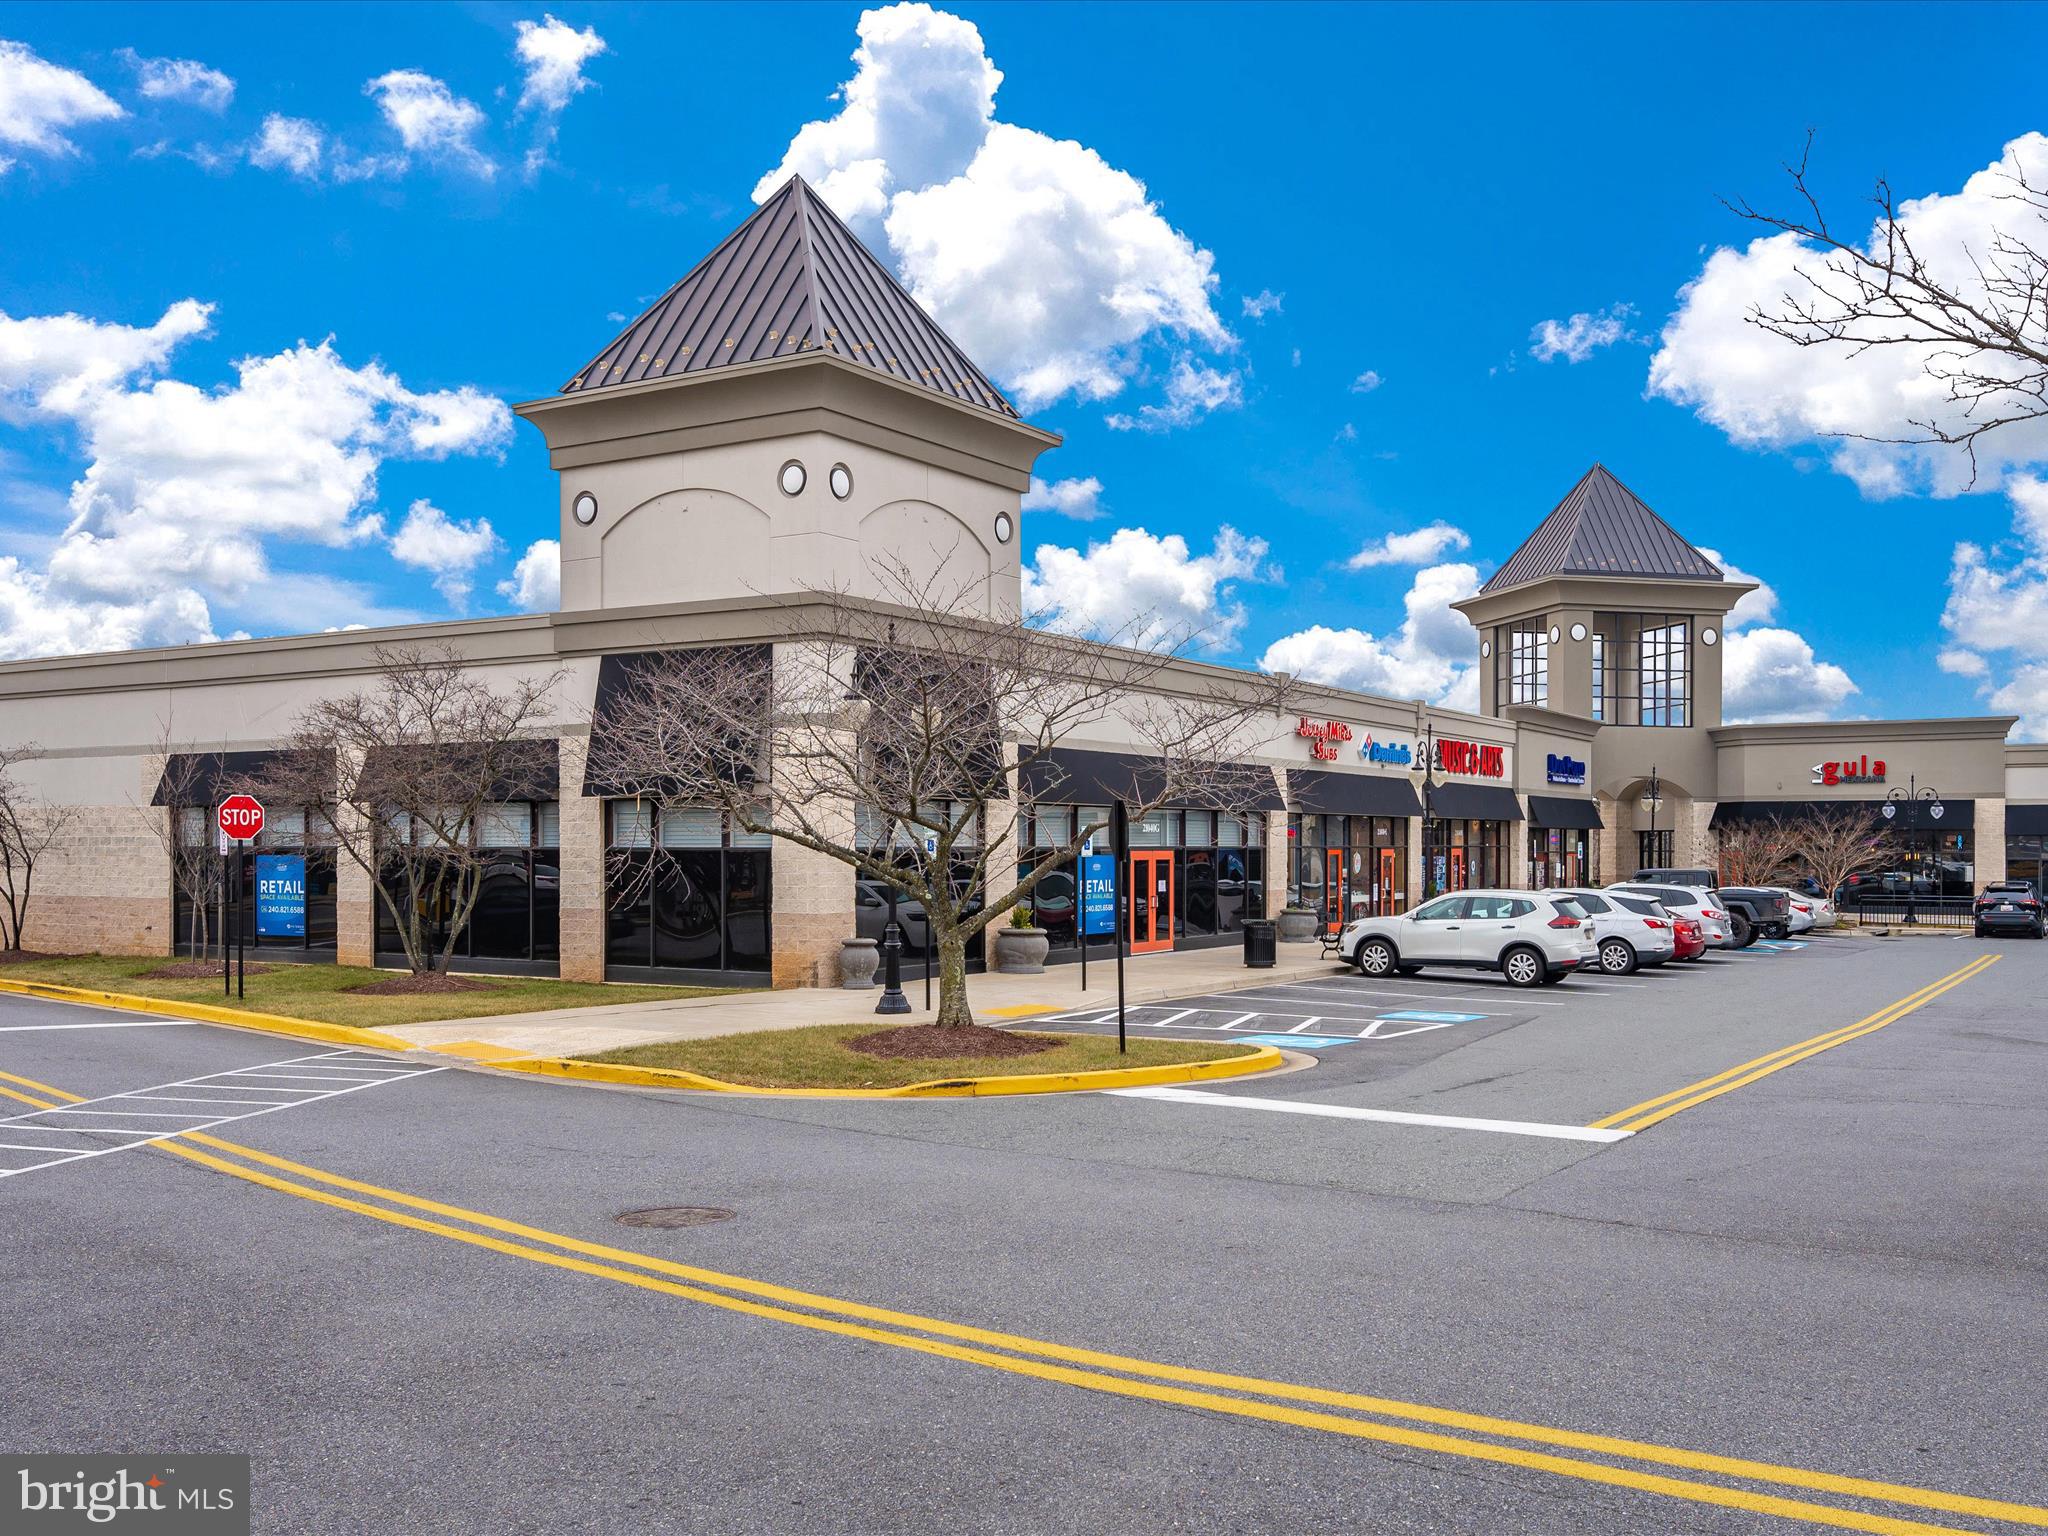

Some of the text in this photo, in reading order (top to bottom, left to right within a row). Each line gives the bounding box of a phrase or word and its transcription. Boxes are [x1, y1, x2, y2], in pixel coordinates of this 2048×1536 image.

[1298, 716, 1328, 743] Jersey
[1369, 741, 1412, 764] Domino's
[1437, 739, 1504, 778] MUSIC & ARTS
[1811, 763, 1823, 784] LA
[1823, 754, 1886, 786] gula
[221, 808, 261, 826] STOP
[260, 880, 305, 894] RETAIL
